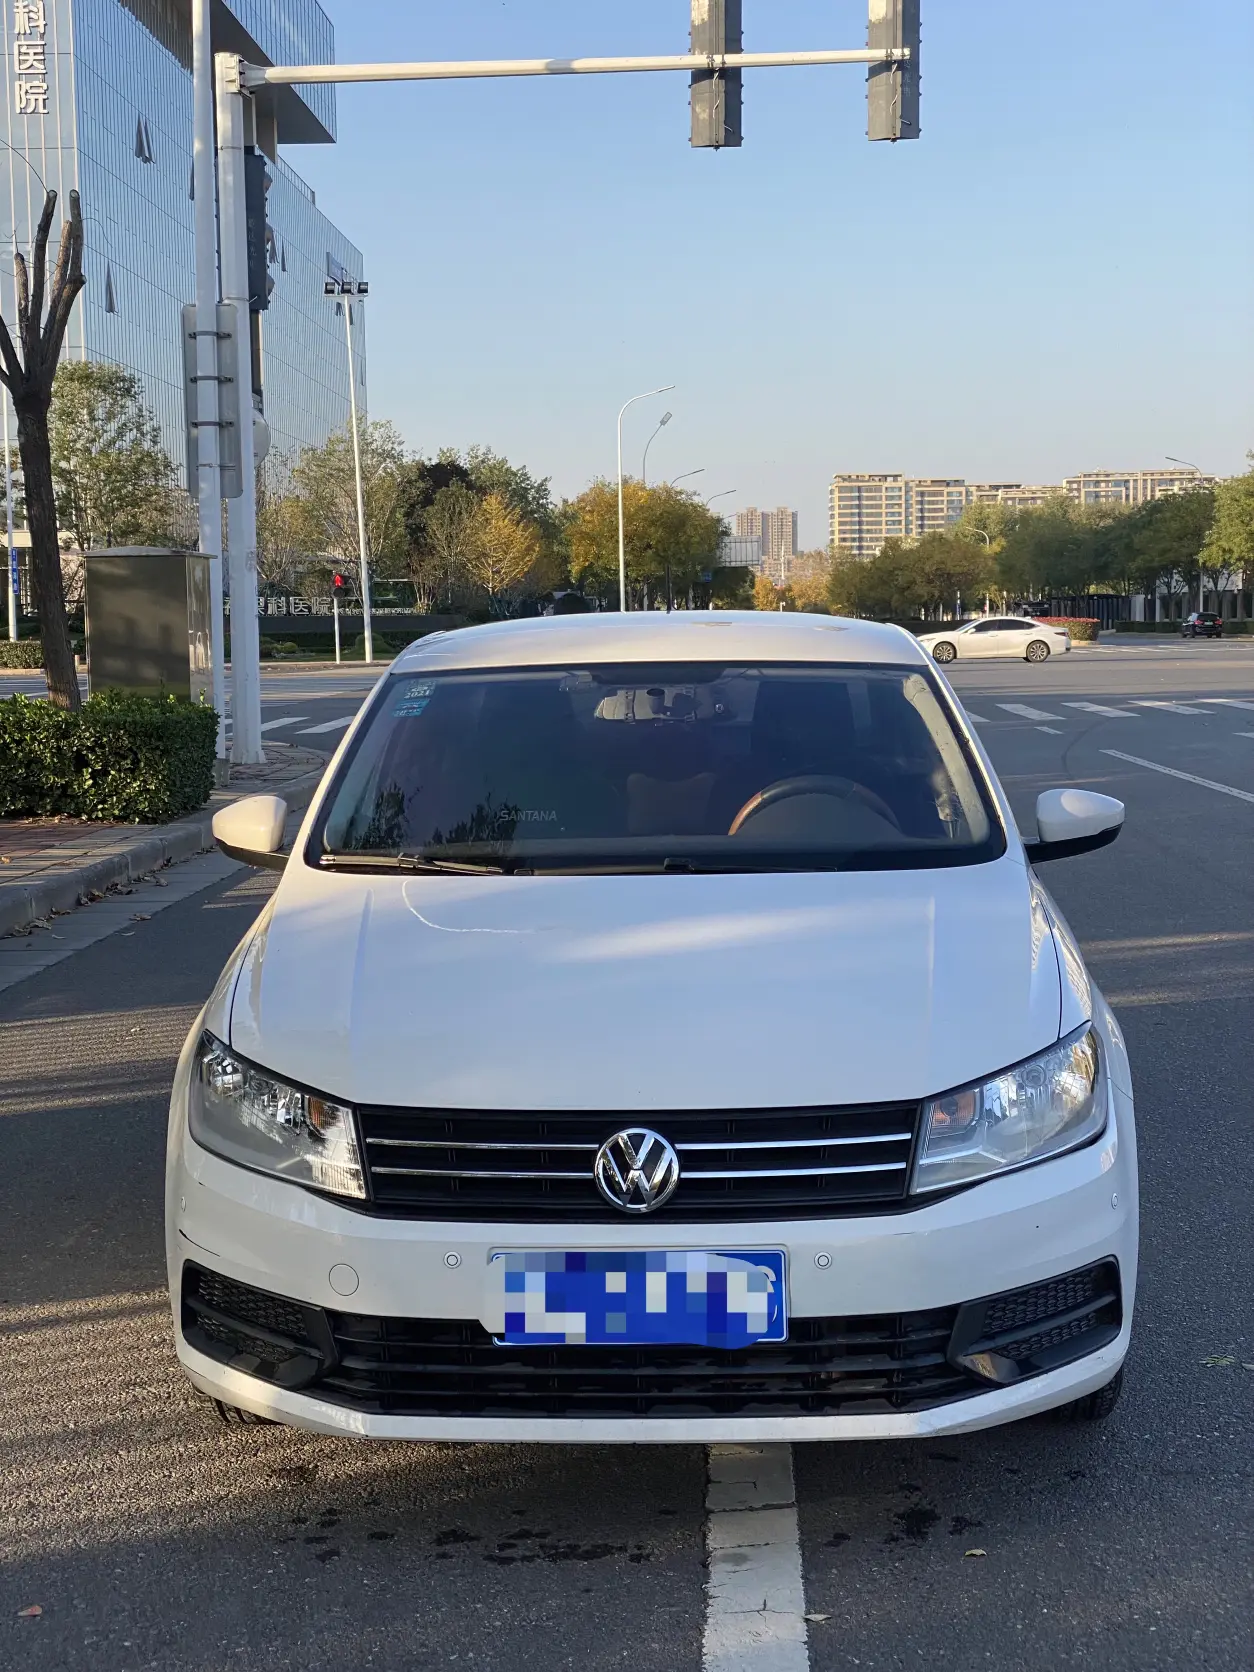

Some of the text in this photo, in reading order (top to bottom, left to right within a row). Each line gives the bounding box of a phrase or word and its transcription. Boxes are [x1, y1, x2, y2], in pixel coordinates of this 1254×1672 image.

[13, 0, 49, 114] 科医院
[500, 810, 558, 821] SANTANA
